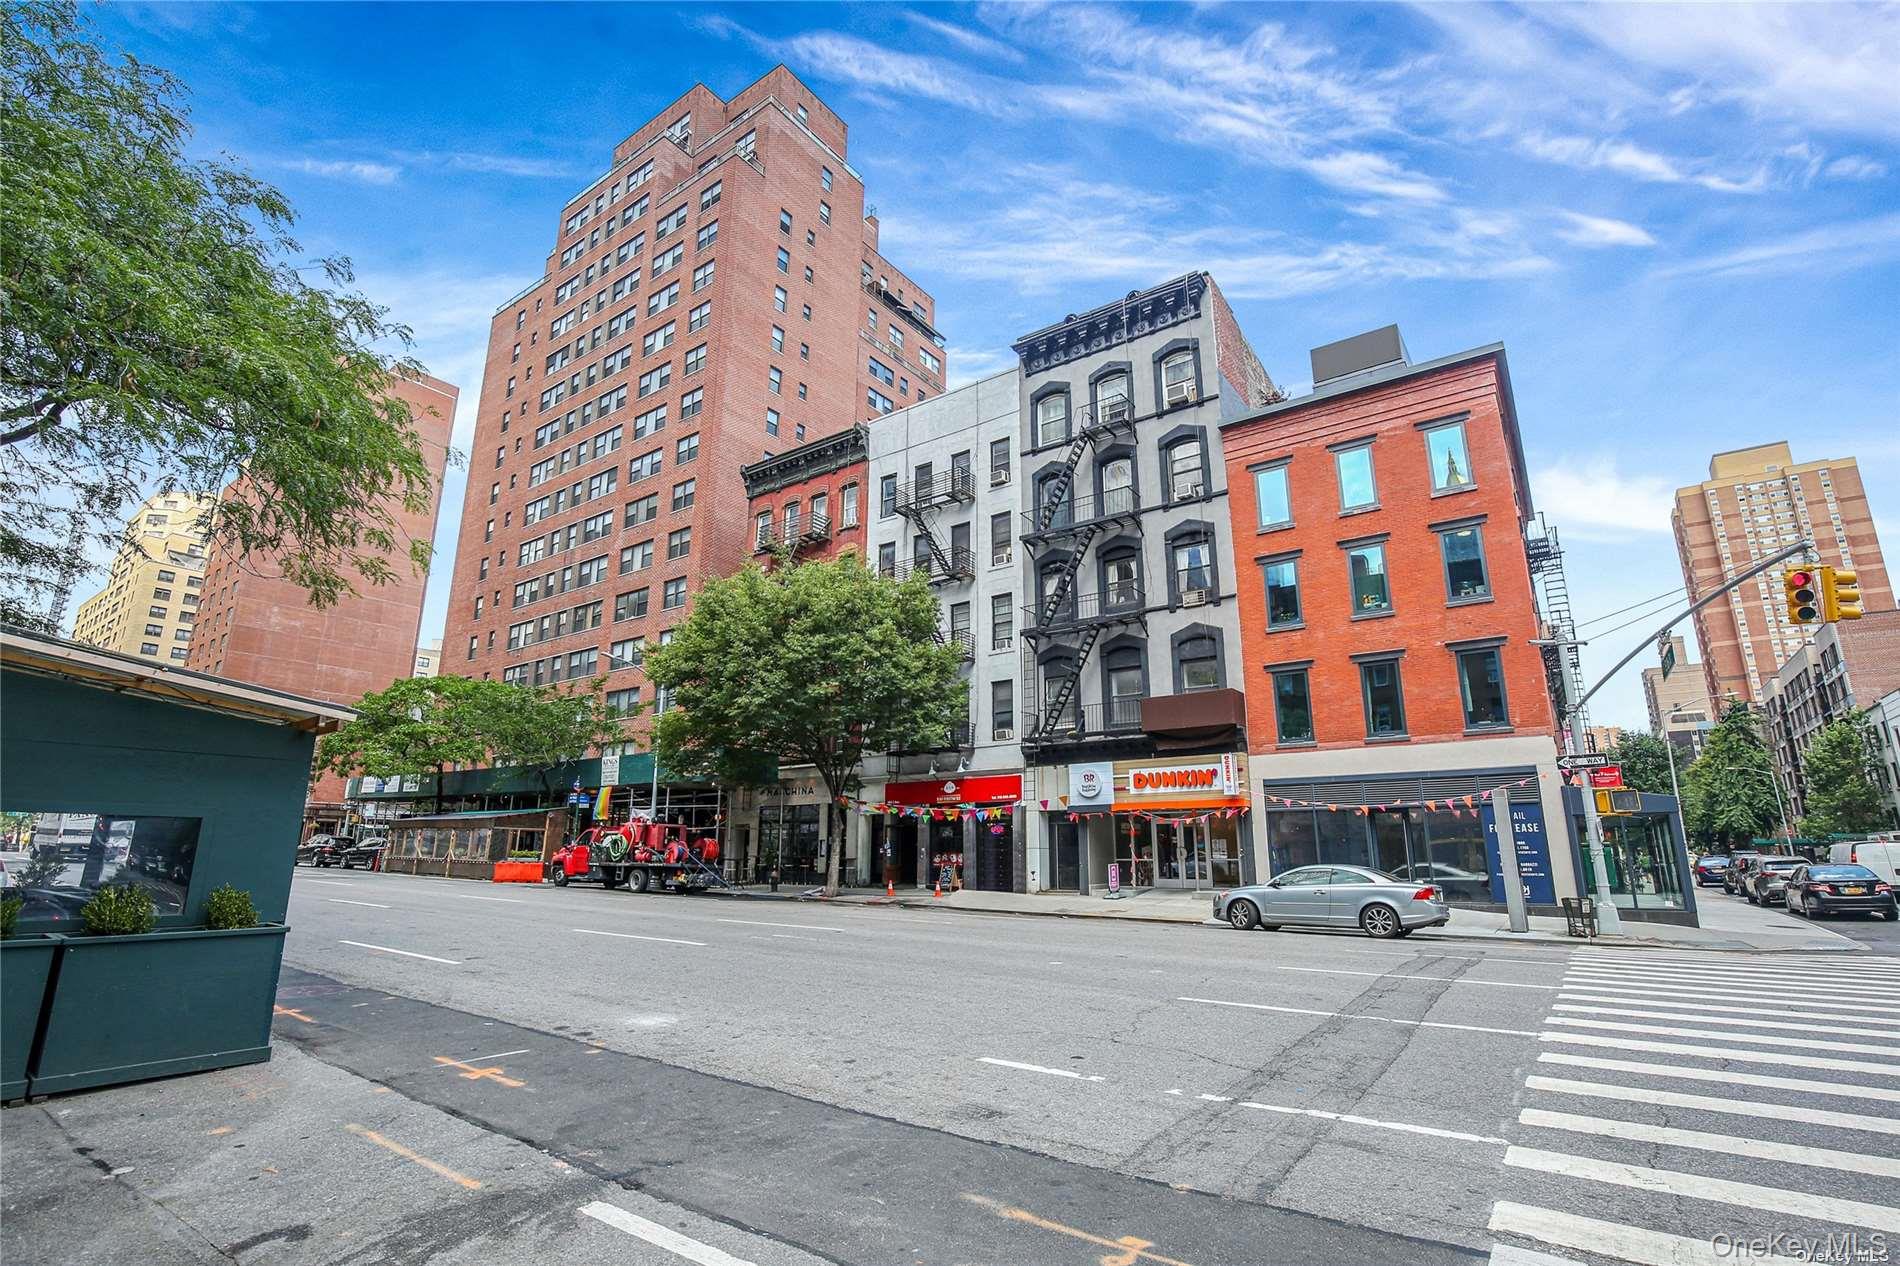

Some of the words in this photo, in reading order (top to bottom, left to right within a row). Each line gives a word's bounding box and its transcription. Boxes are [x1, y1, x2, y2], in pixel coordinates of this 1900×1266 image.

[1586, 756, 1603, 764] WAY
[1083, 773, 1095, 782] BR
[1133, 768, 1218, 789] DUNKIN'
[1514, 823, 1540, 833] EASE
